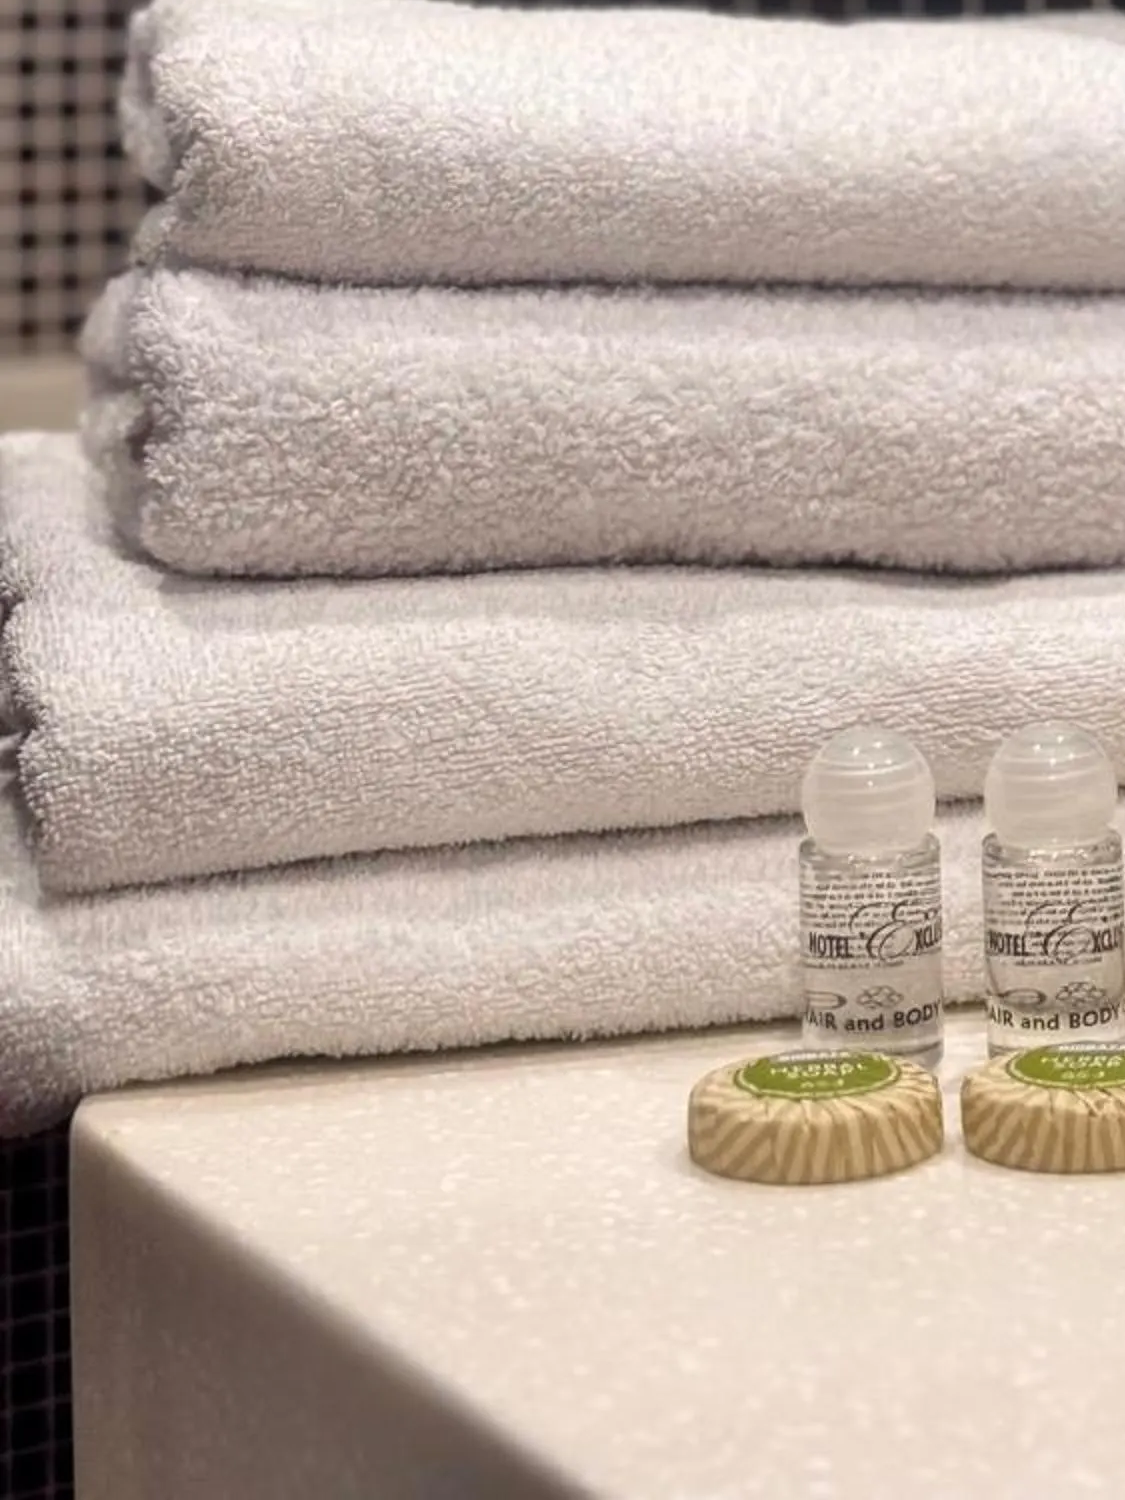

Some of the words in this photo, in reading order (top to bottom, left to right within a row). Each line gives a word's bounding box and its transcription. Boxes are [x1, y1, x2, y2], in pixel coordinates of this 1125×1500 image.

[809, 931, 853, 959] HOTEL
[844, 1014, 884, 1031] and
[894, 1000, 941, 1028] BODY
[1021, 1013, 1060, 1030] and
[1069, 1002, 1120, 1028] BODY
